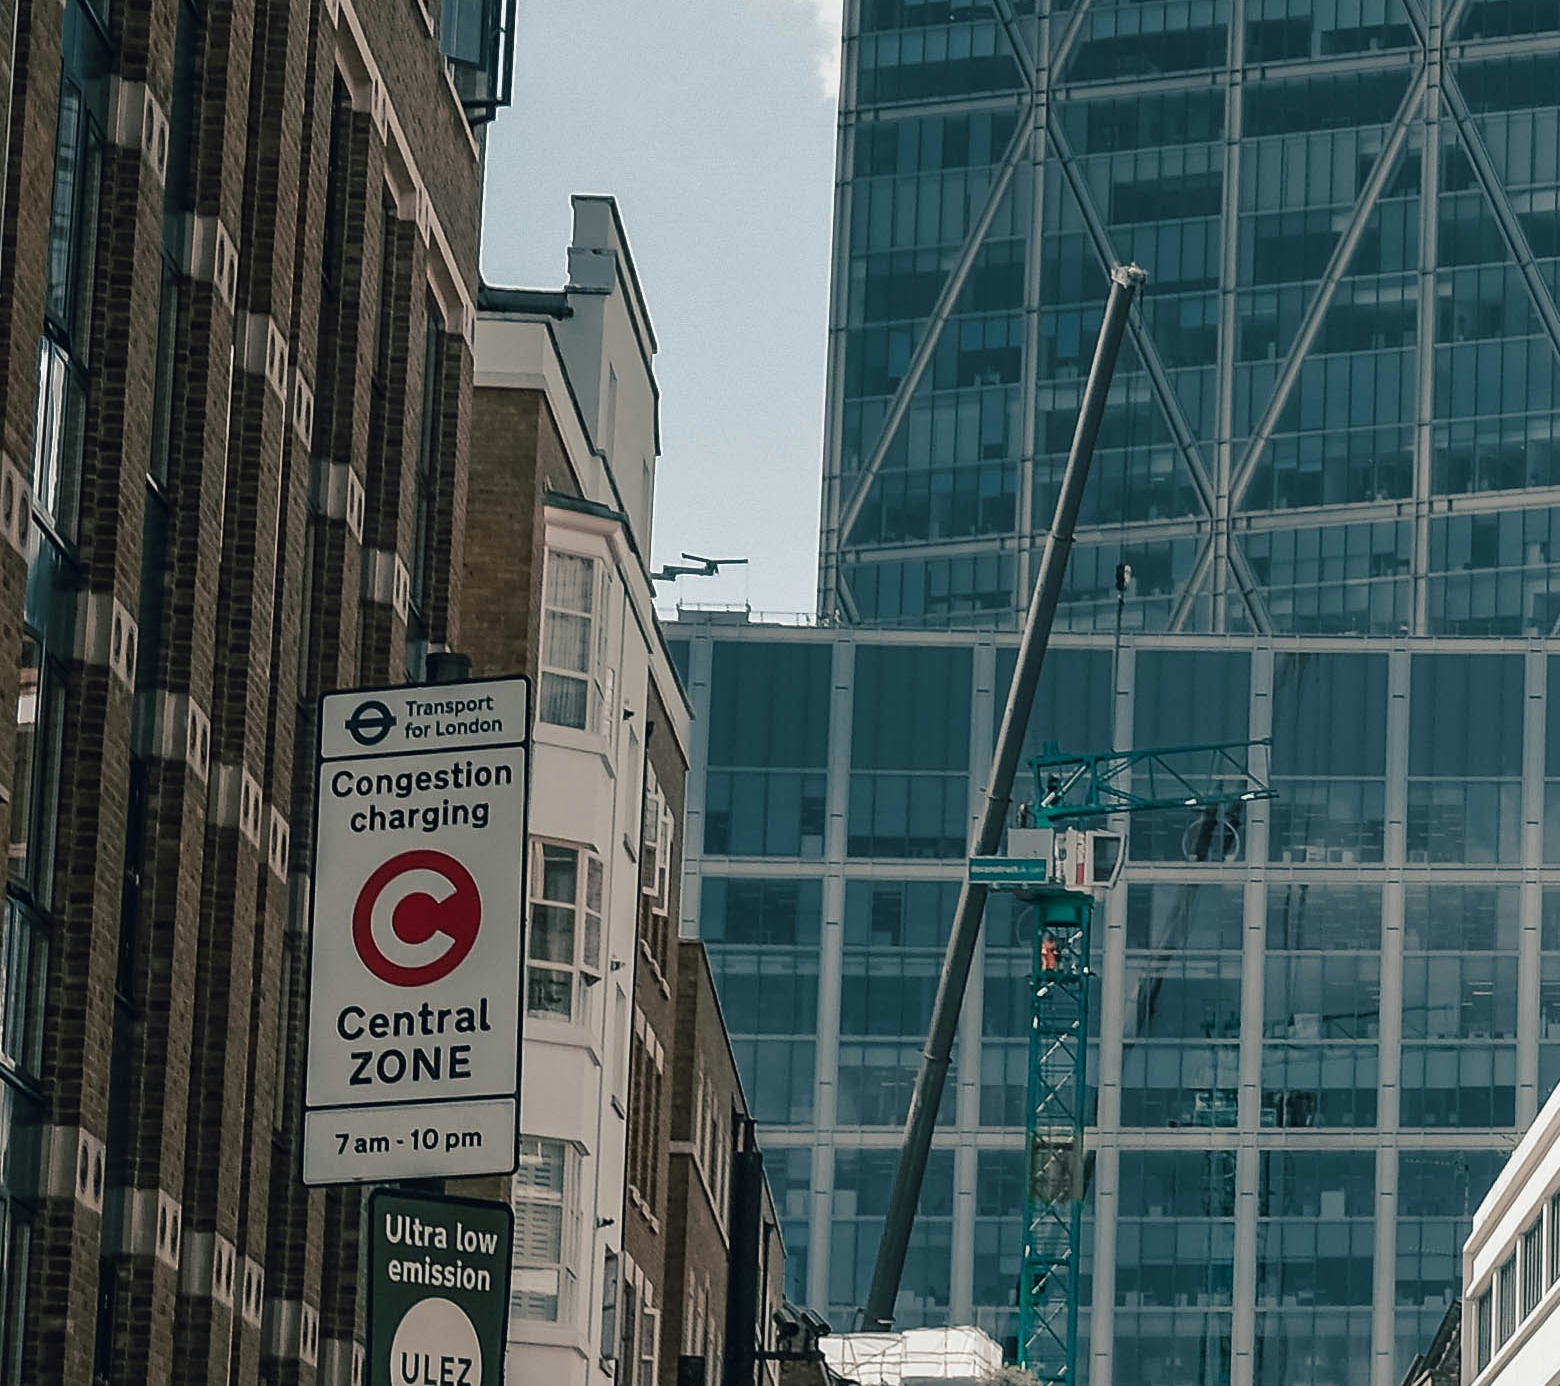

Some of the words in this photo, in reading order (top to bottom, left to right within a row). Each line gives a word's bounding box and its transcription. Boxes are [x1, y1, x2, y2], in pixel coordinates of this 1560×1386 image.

[404, 695, 495, 718] Transport
[404, 722, 431, 739] for
[435, 717, 503, 737] London
[331, 761, 512, 798] Congestion
[350, 799, 490, 833] charging
[336, 997, 492, 1041] Central
[349, 1044, 472, 1085] ZONE
[335, 1133, 349, 1155] 7
[353, 1135, 390, 1154] am
[410, 1128, 439, 1151] 10
[445, 1131, 482, 1153] pm
[385, 1213, 447, 1250] Ultra
[456, 1221, 498, 1255] low
[387, 1256, 491, 1292] emission
